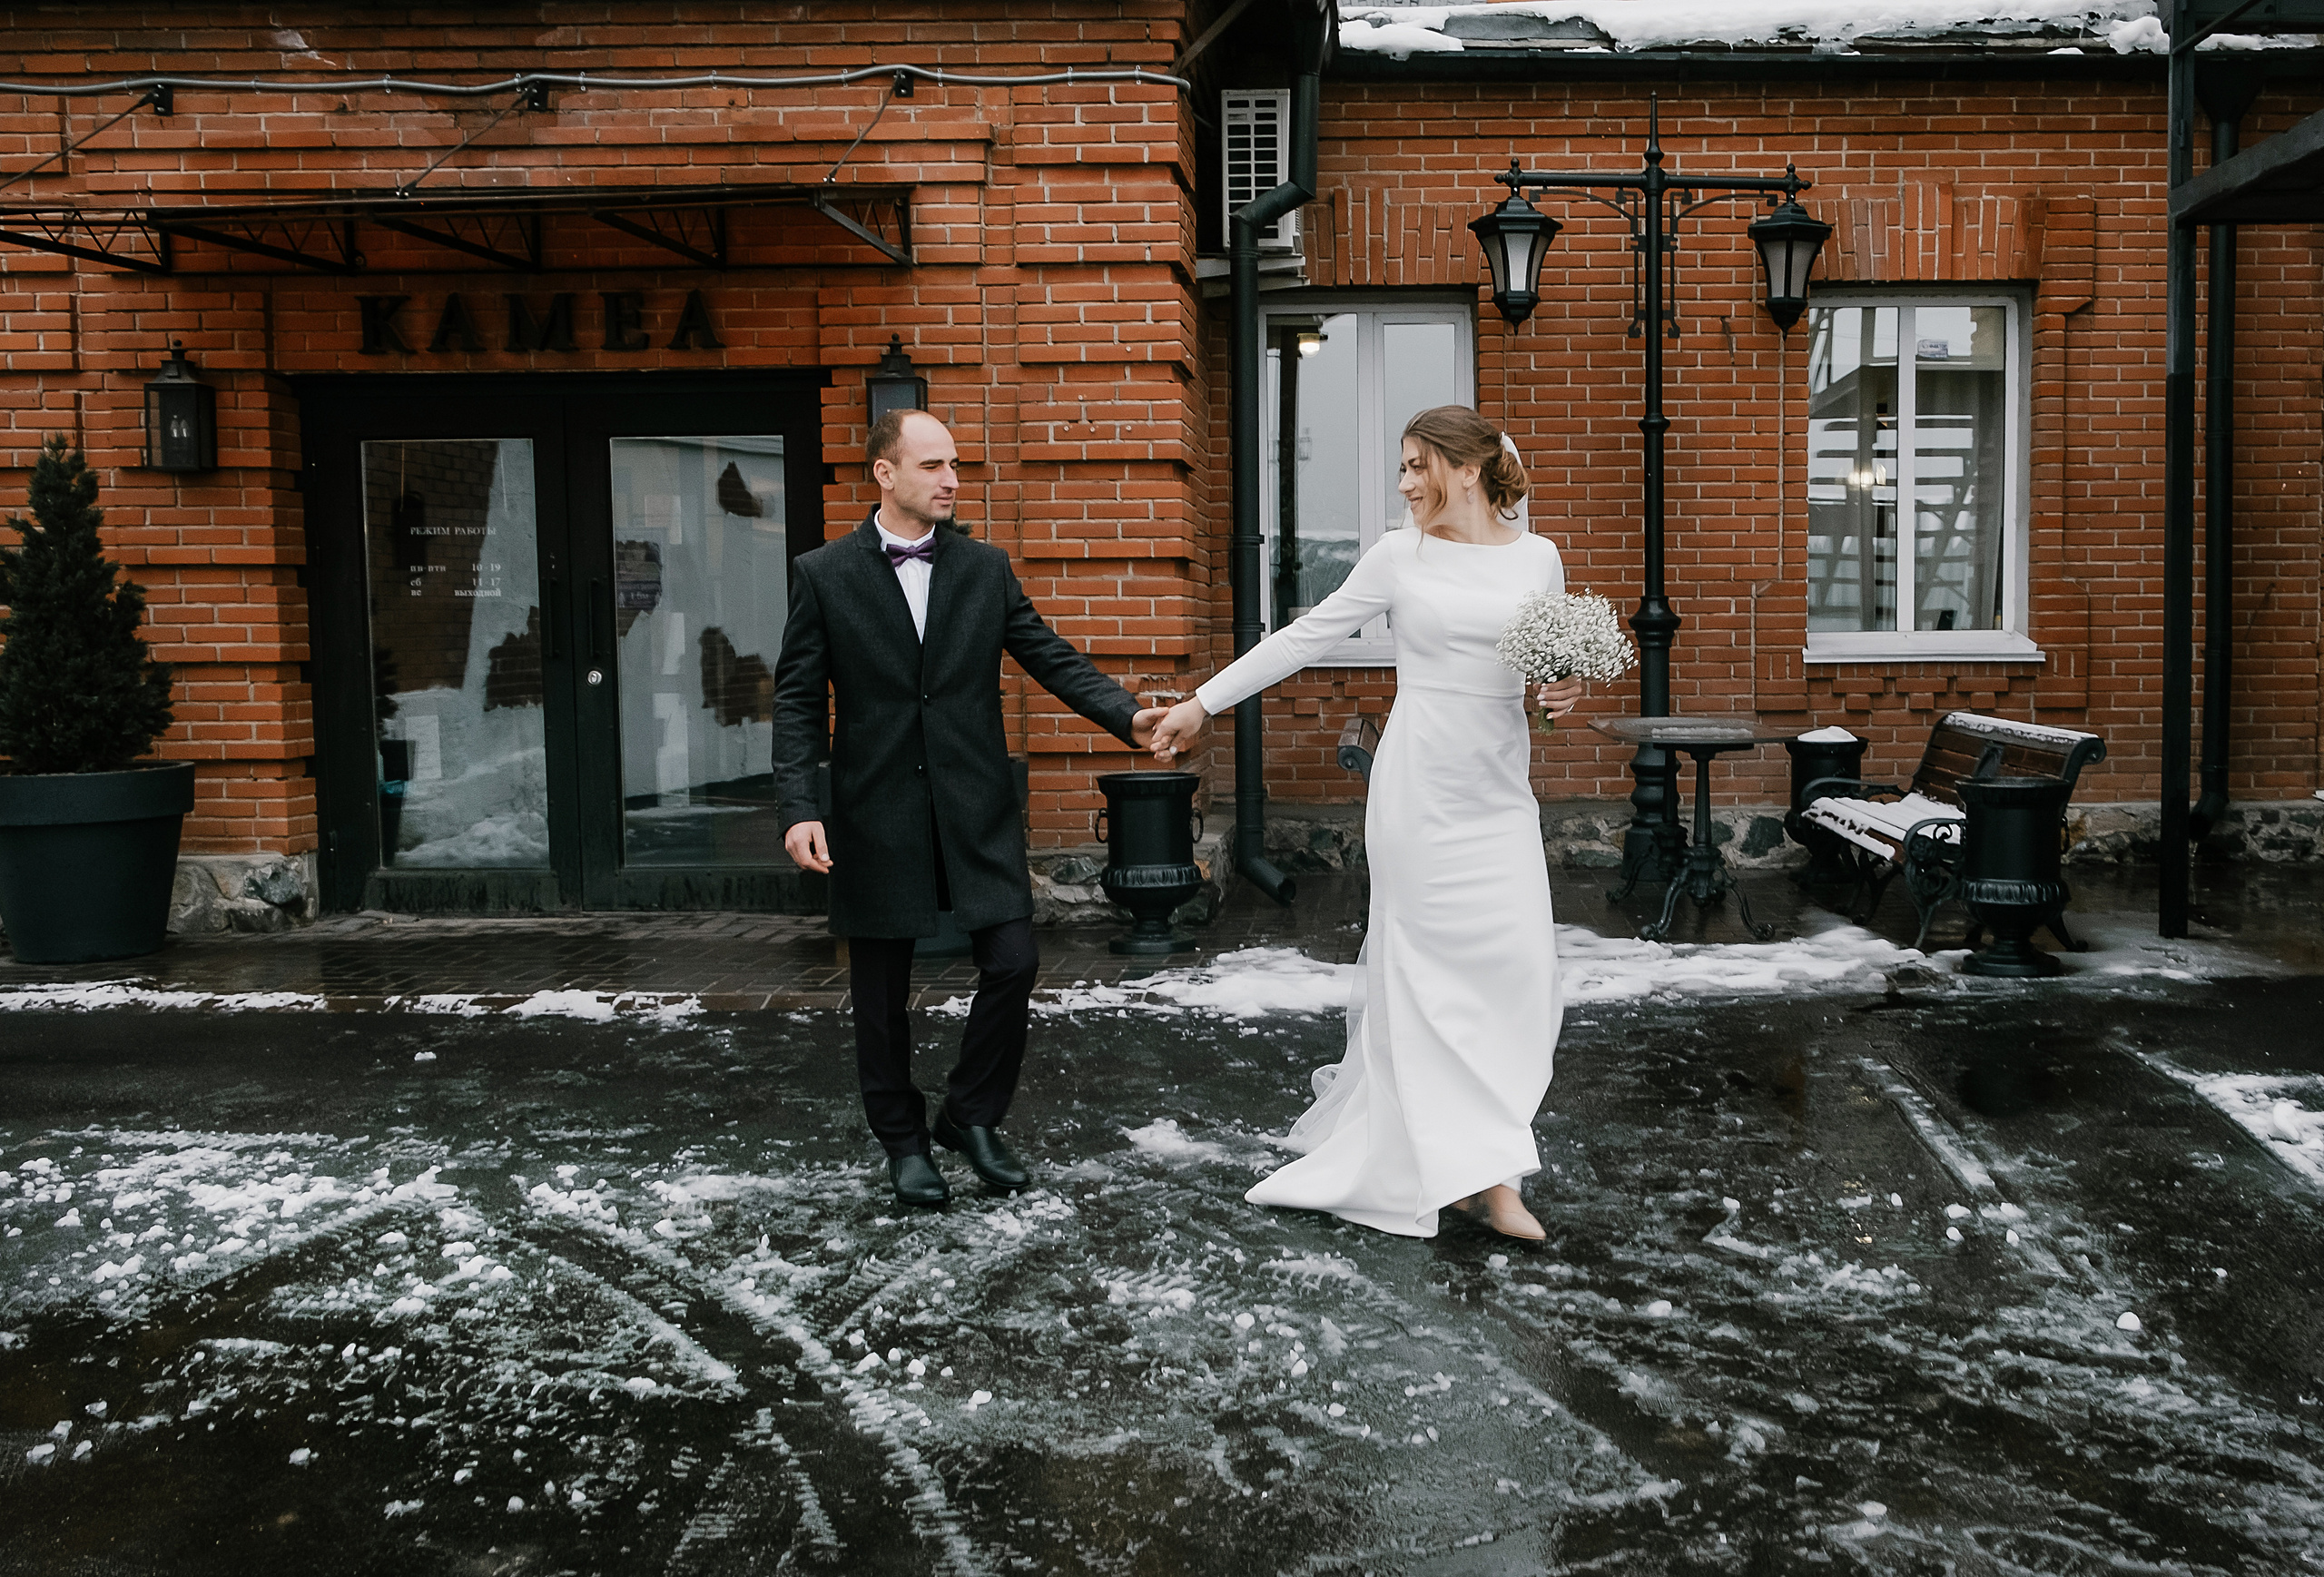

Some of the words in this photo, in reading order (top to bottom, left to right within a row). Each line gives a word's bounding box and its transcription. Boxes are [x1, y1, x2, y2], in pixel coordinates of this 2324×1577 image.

[355, 289, 727, 355] КАМЕА
[409, 527, 450, 536] РЕЖИМ
[454, 527, 497, 536] РАБОТЫ
[409, 577, 422, 586] сб
[454, 587, 501, 597] выходной
